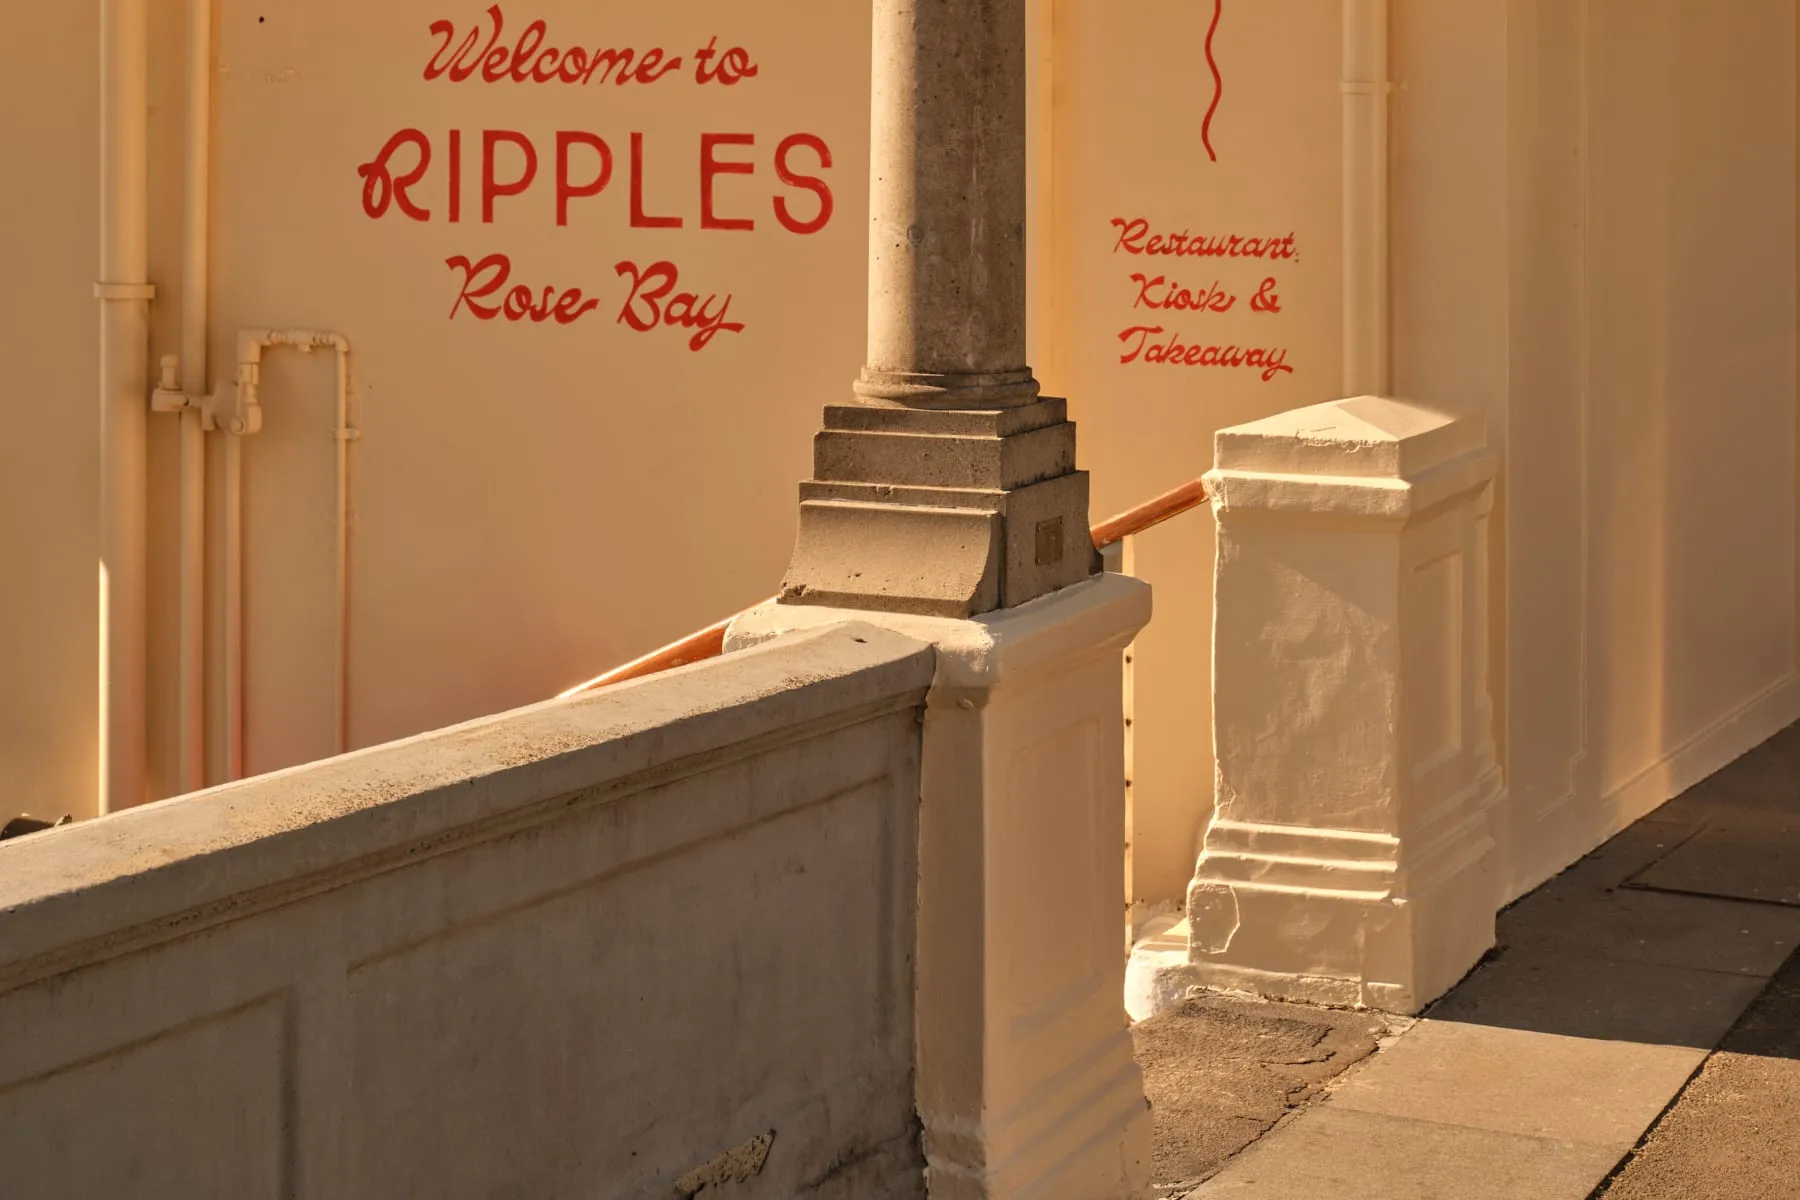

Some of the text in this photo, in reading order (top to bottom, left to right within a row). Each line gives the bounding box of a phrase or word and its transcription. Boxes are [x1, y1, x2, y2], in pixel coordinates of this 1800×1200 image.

[423, 4, 758, 86] Welcome to
[358, 128, 834, 235] RIPPLES
[446, 253, 745, 352] Rose Bay
[1130, 273, 1281, 313] Kiosk &
[1118, 326, 1293, 382] Takeaway
